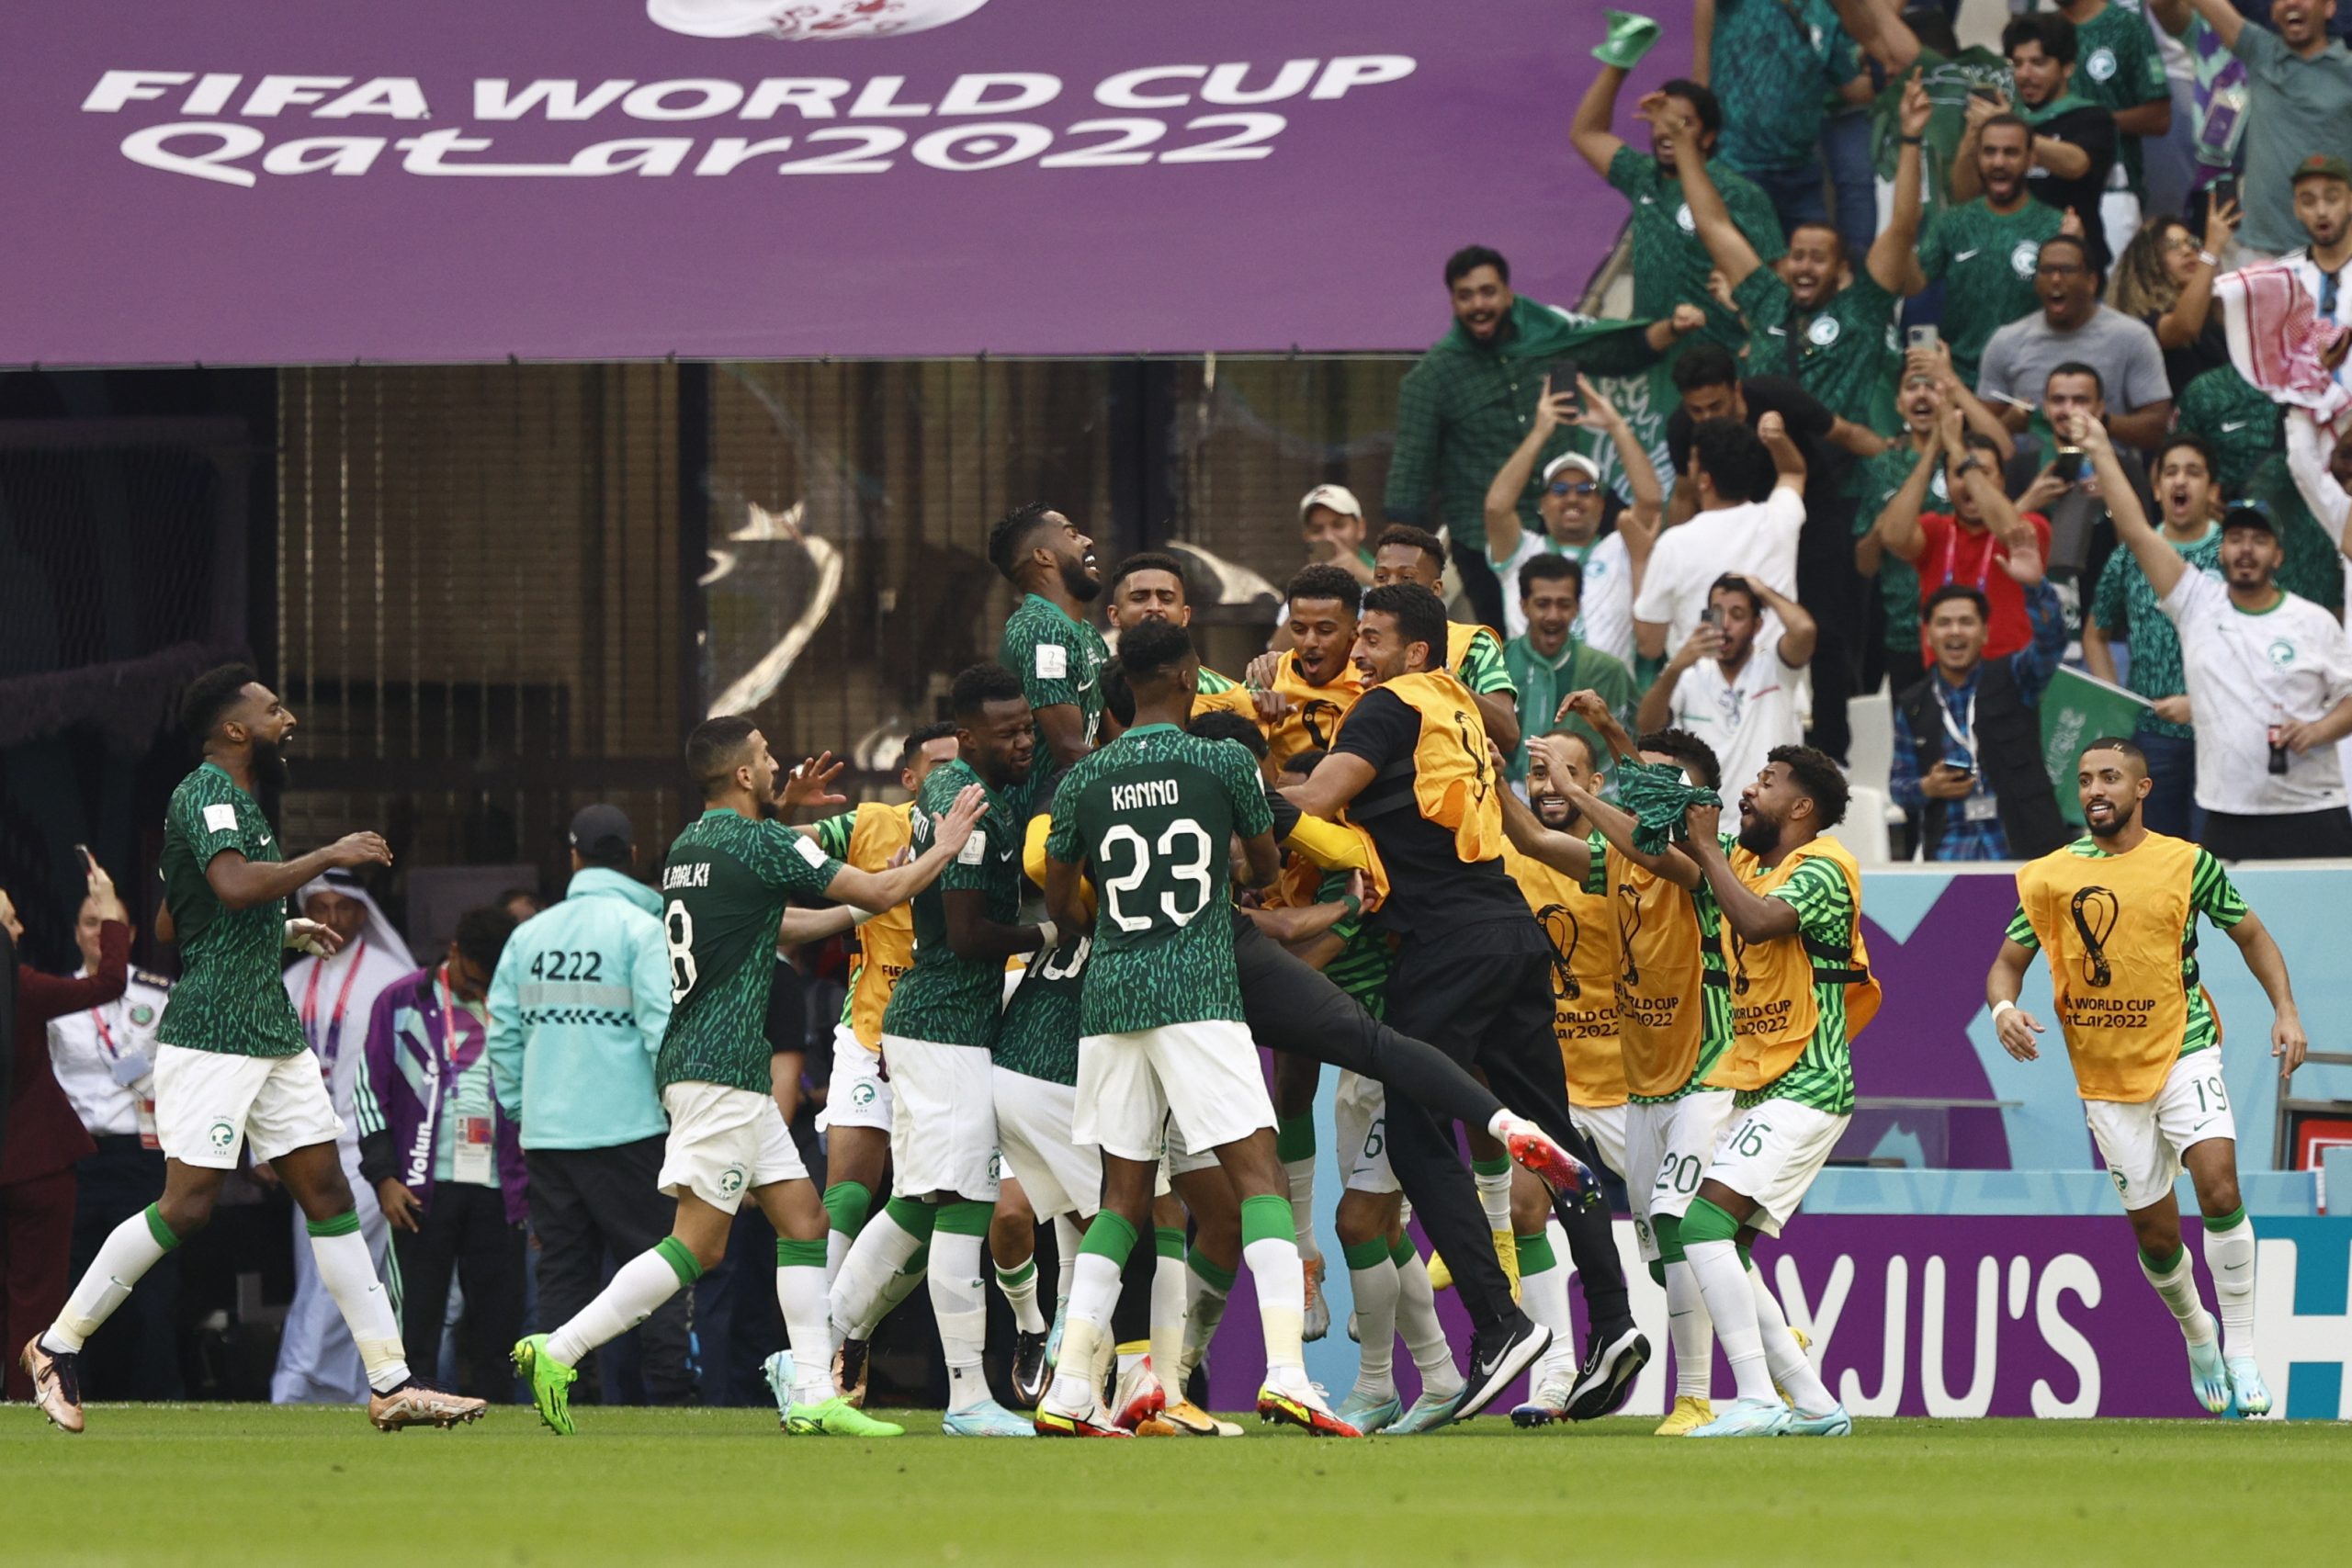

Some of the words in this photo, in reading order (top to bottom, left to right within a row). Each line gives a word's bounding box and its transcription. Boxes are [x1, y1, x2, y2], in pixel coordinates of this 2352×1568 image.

[81, 70, 427, 119] FIFA
[473, 73, 1062, 120] WORLD
[1094, 55, 1417, 108] CUP
[1111, 779, 1179, 811] KANNO
[662, 863, 711, 891] LMALKI
[1100, 818, 1213, 932] 23
[531, 950, 603, 983] 4222
[1556, 1010, 1597, 1024] ORLD
[1655, 996, 1679, 1010] CUP
[1765, 999, 1792, 1015] CUP
[2075, 998, 2124, 1011] WORLD
[2126, 998, 2156, 1011] CUP
[2191, 1076, 2227, 1112] 19
[1728, 1118, 1772, 1157] 16
[1656, 1152, 1702, 1194] 20
[1711, 1250, 2103, 1419] YJU'S
